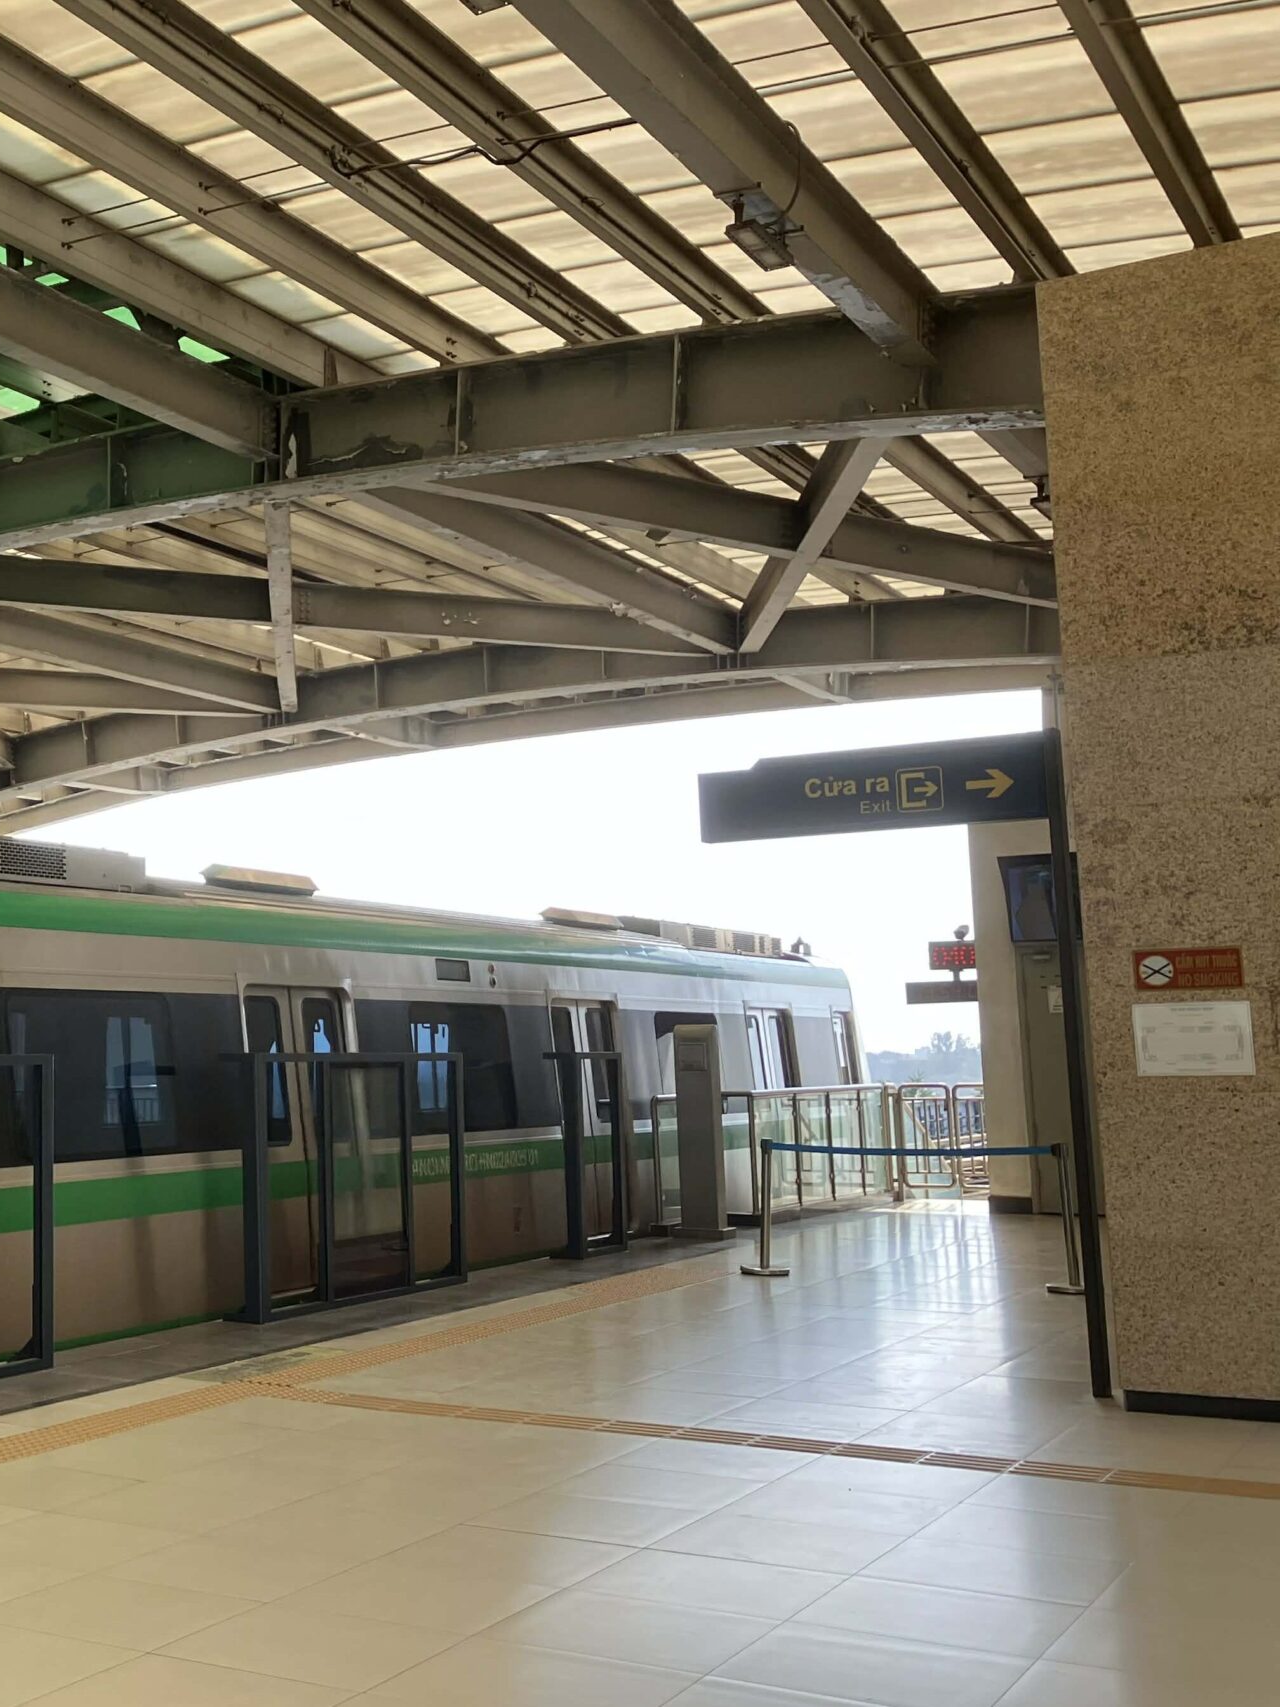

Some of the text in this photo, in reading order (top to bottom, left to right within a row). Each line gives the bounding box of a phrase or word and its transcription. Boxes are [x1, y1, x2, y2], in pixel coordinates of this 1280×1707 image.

[804, 776, 890, 799] Cửa ra
[859, 800, 893, 815] Exit
[1178, 971, 1240, 987] NO SMOKING
